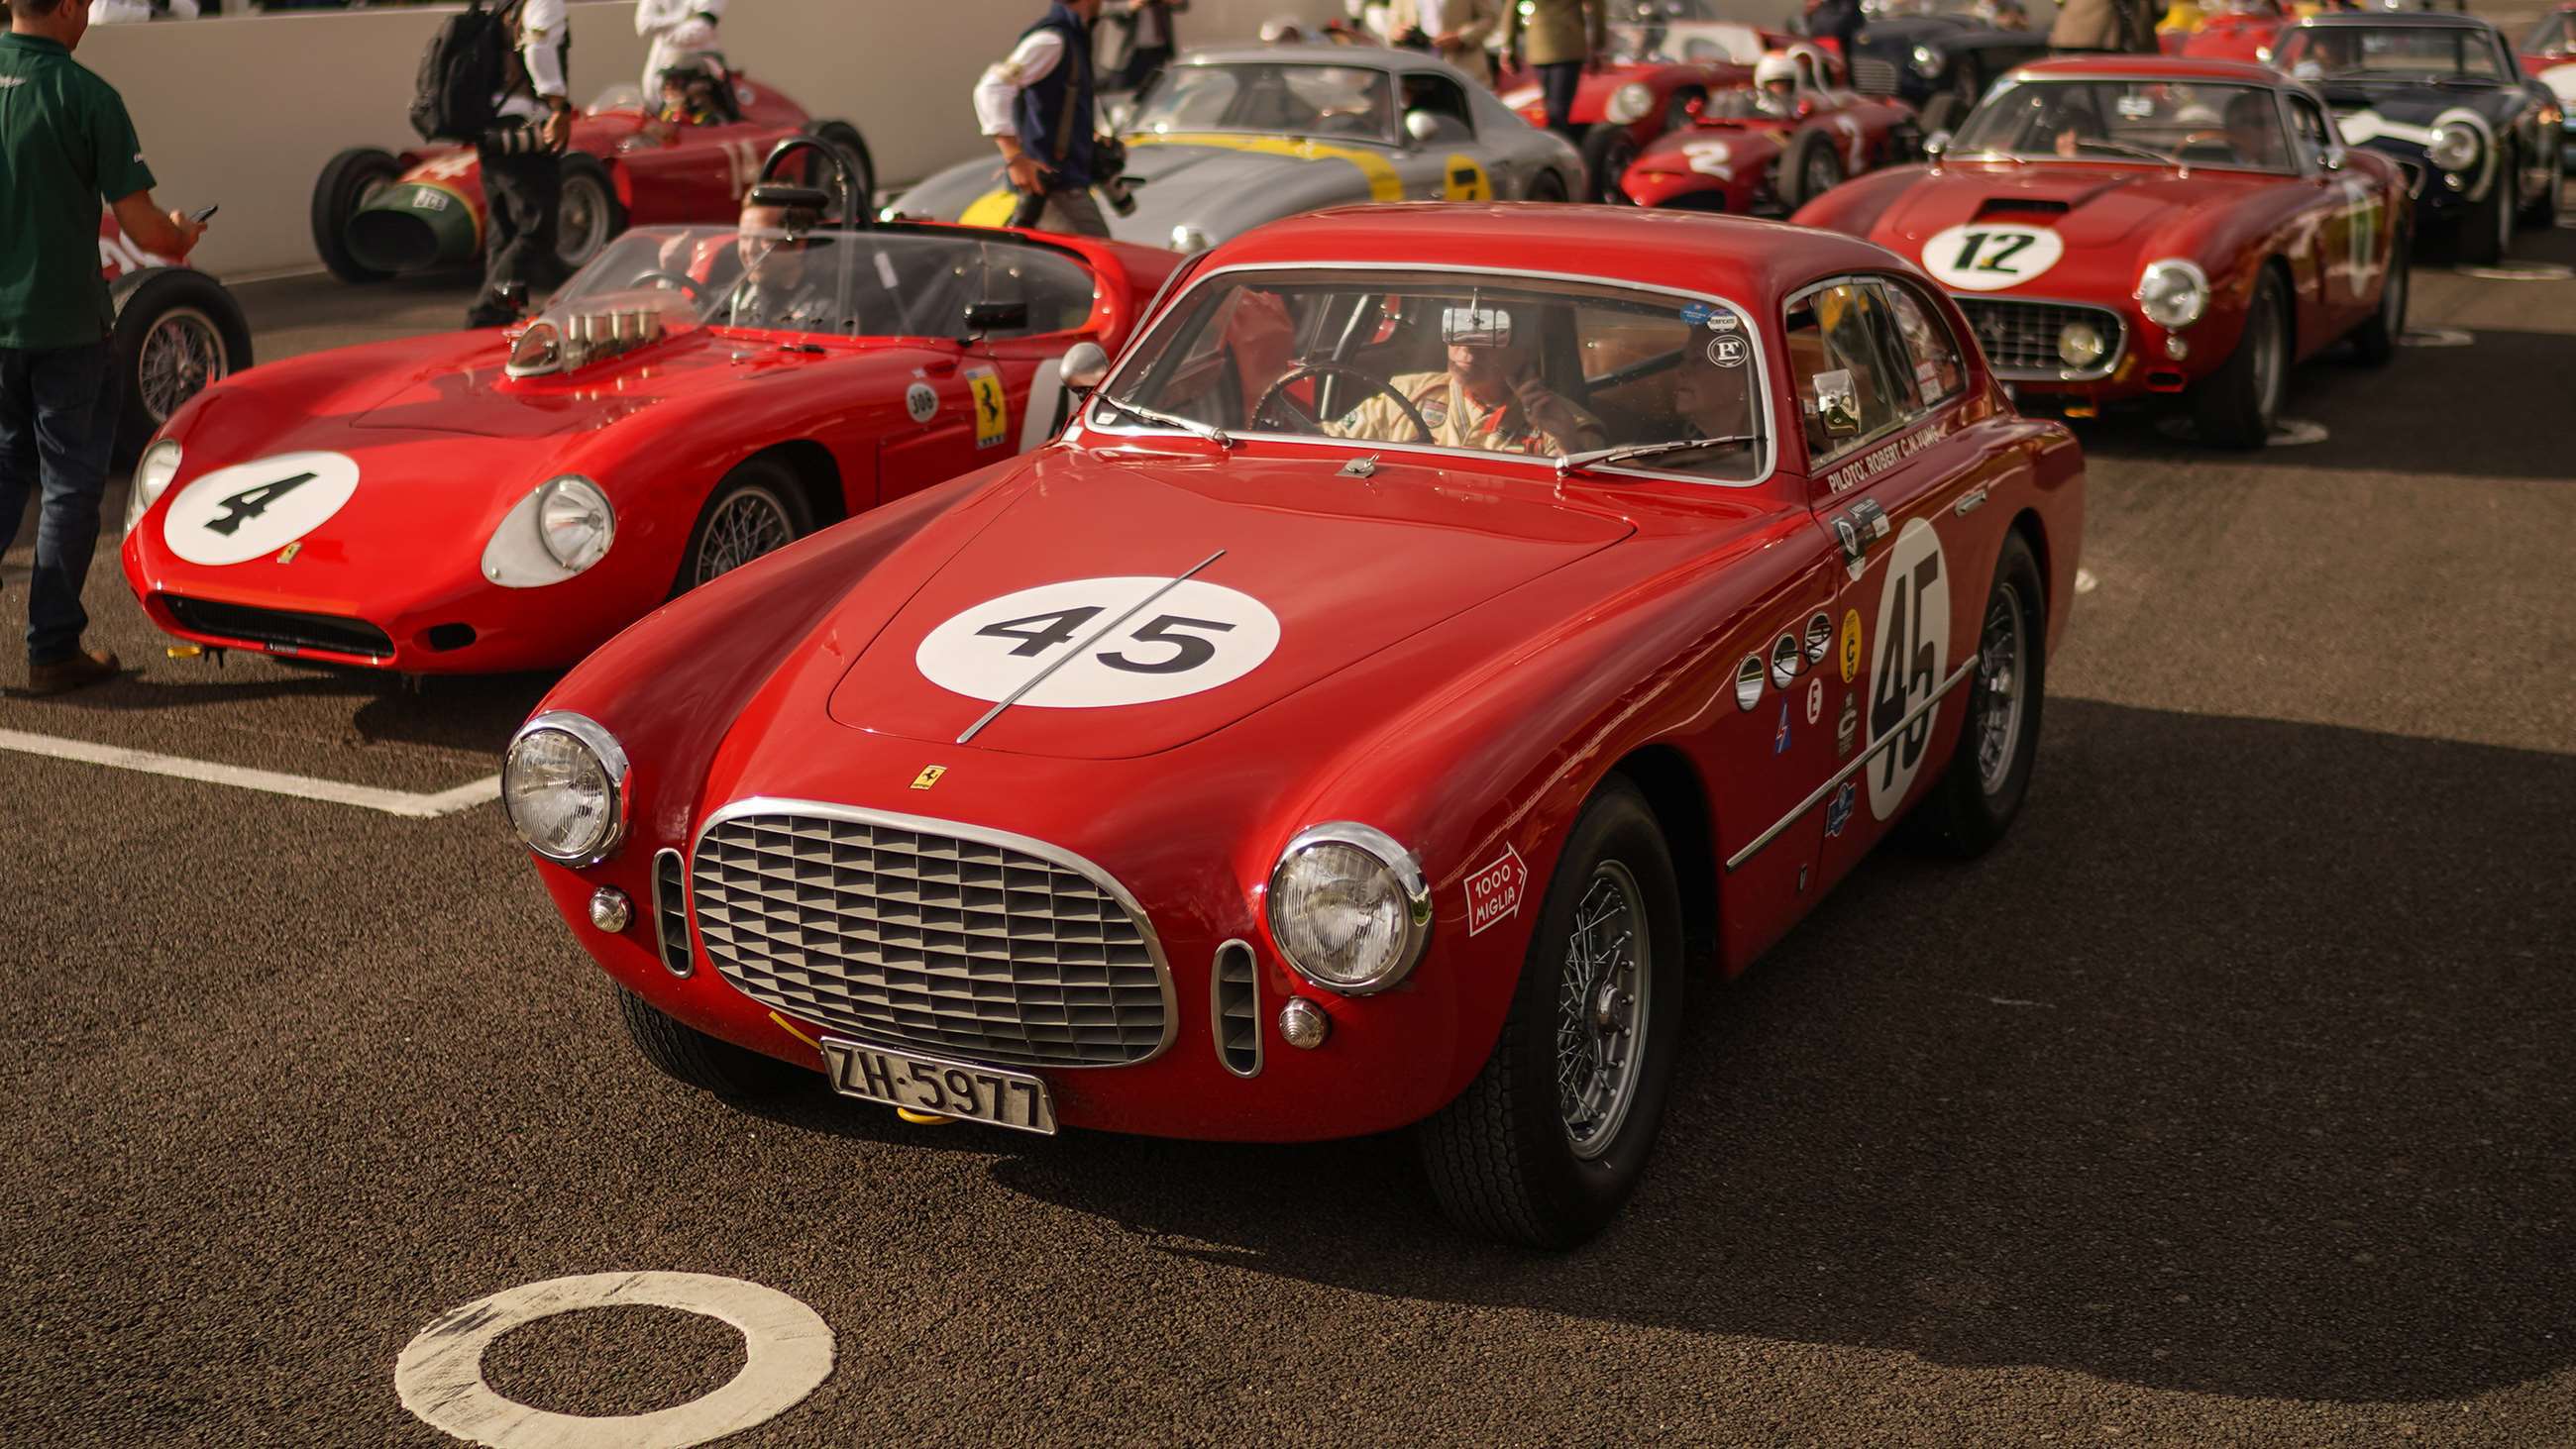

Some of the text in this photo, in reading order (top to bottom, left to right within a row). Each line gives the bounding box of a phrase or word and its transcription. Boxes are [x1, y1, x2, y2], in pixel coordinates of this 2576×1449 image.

[1682, 141, 1732, 182] 2
[1954, 233, 2036, 273] 12
[1866, 443, 1902, 475] ROBERT
[203, 471, 319, 537] 4
[973, 605, 1237, 674] 45
[1870, 549, 1939, 794] 45
[1474, 864, 1511, 899] 1000
[1475, 885, 1515, 926] MIGLIA
